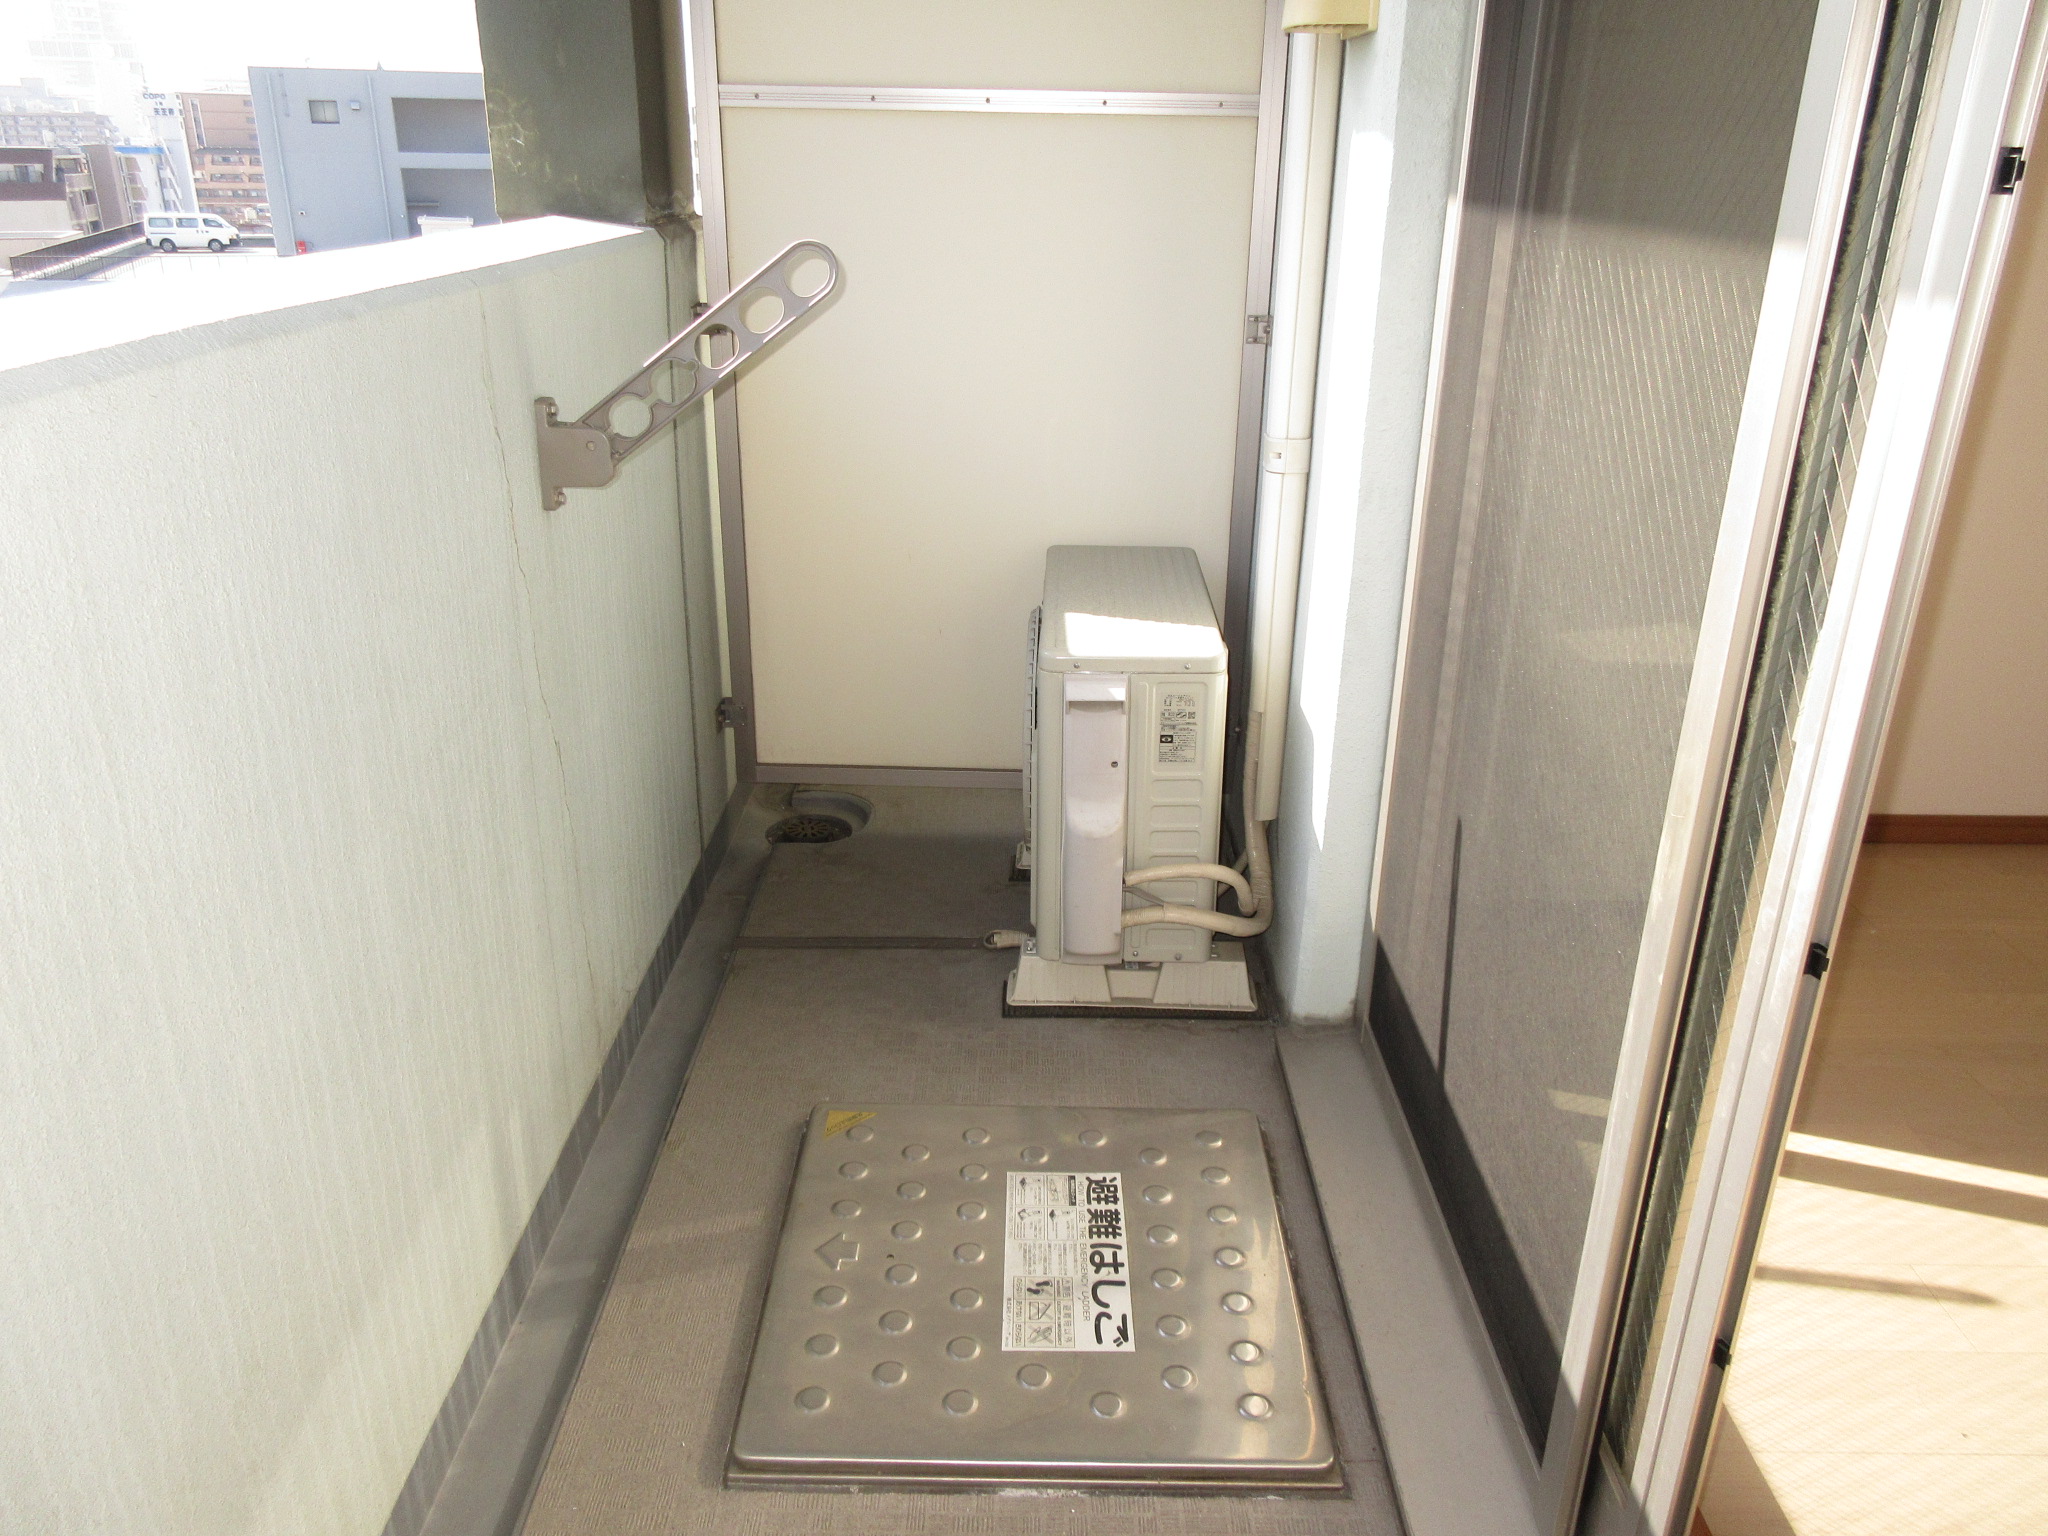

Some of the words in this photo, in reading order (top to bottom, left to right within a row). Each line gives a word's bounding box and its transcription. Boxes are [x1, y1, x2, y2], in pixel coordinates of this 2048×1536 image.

[1076, 1180, 1084, 1196] HOW
[1077, 1198, 1085, 1207] TO
[1078, 1210, 1086, 1223] USE
[1078, 1226, 1087, 1240] THE
[1079, 1242, 1089, 1287] EMERGENCY
[1085, 1176, 1129, 1347] 避難はしご
[1081, 1290, 1091, 1321] LADDER
